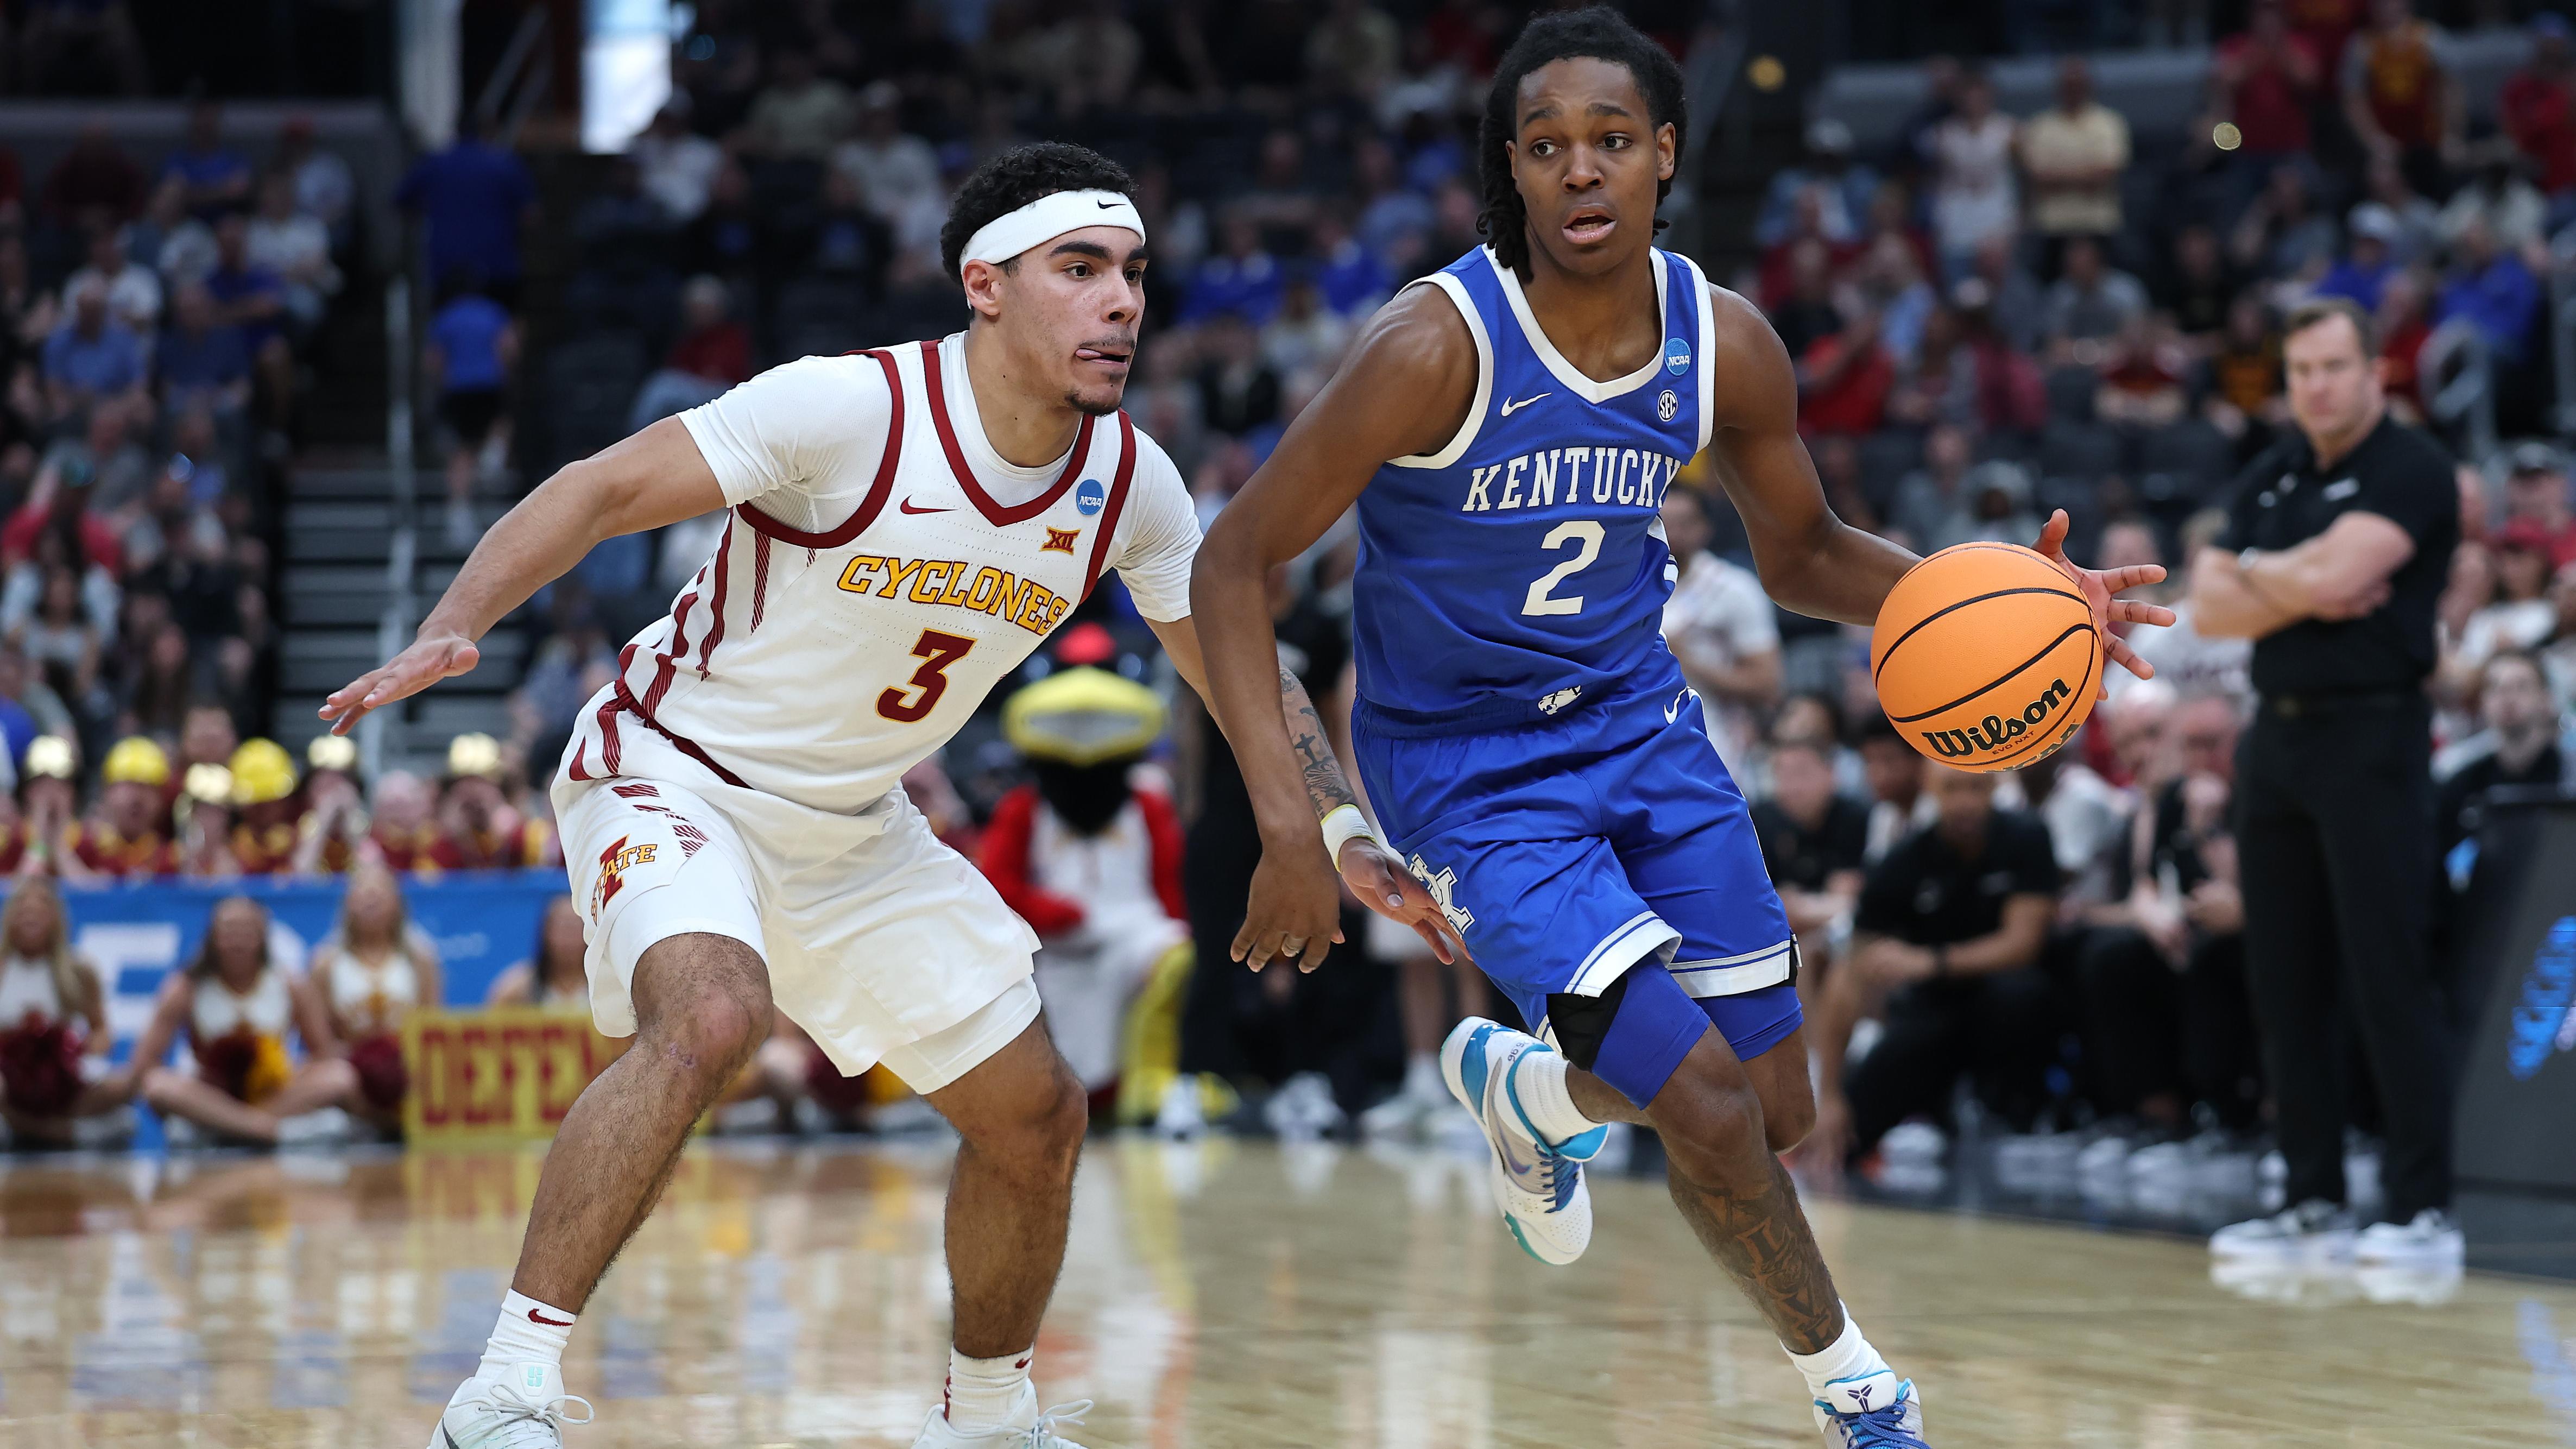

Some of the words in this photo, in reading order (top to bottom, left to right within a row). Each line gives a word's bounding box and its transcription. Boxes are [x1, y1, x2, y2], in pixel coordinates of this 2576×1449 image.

[1668, 355, 1690, 367] NCAA
[1660, 392, 1677, 419] SEC
[1079, 495, 1102, 507] NCAA
[1462, 446, 1681, 512] KENTUCKY
[837, 555, 1070, 637] CYCLONES
[1520, 520, 1606, 616] 2
[875, 627, 978, 723] 3
[1921, 677, 2072, 757] Wilson
[1992, 744, 2013, 755] EVO
[2015, 730, 2034, 745] NXT
[591, 843, 658, 927] STATE
